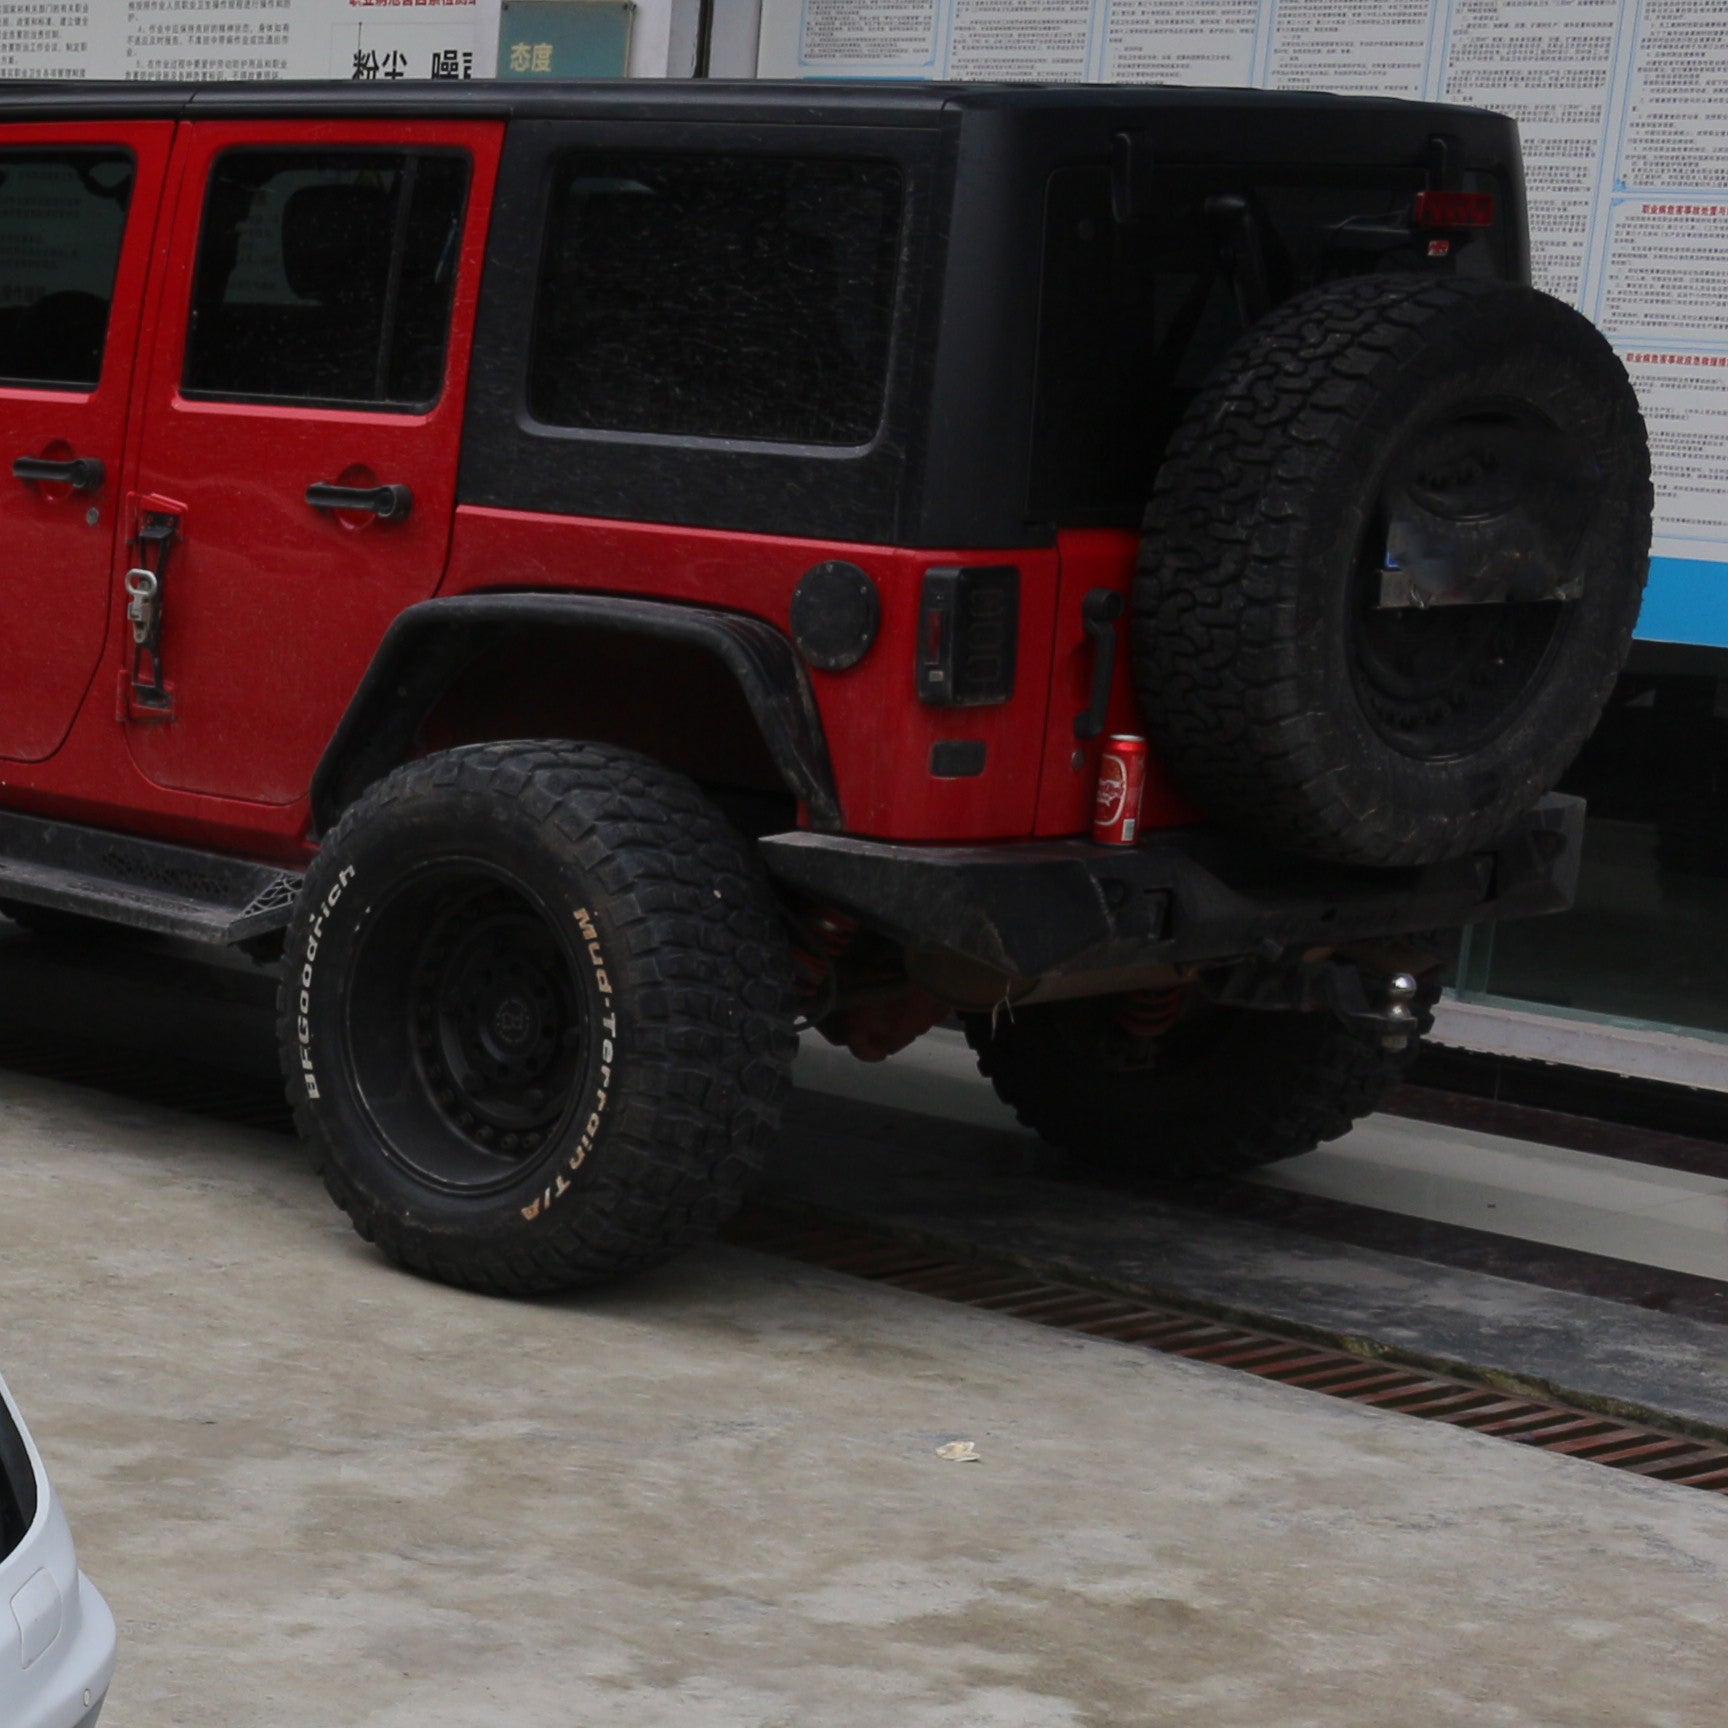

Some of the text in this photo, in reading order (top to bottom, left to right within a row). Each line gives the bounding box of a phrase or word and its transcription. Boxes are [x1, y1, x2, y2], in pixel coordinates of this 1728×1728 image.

[352, 50, 407, 79] 粉尘
[509, 42, 553, 72] 态度
[1641, 203, 1728, 217] 职业病危害事故处置与
[1626, 352, 1728, 368] 职业病危害事故应急救援措
[296, 864, 356, 1099] BFGoodrich
